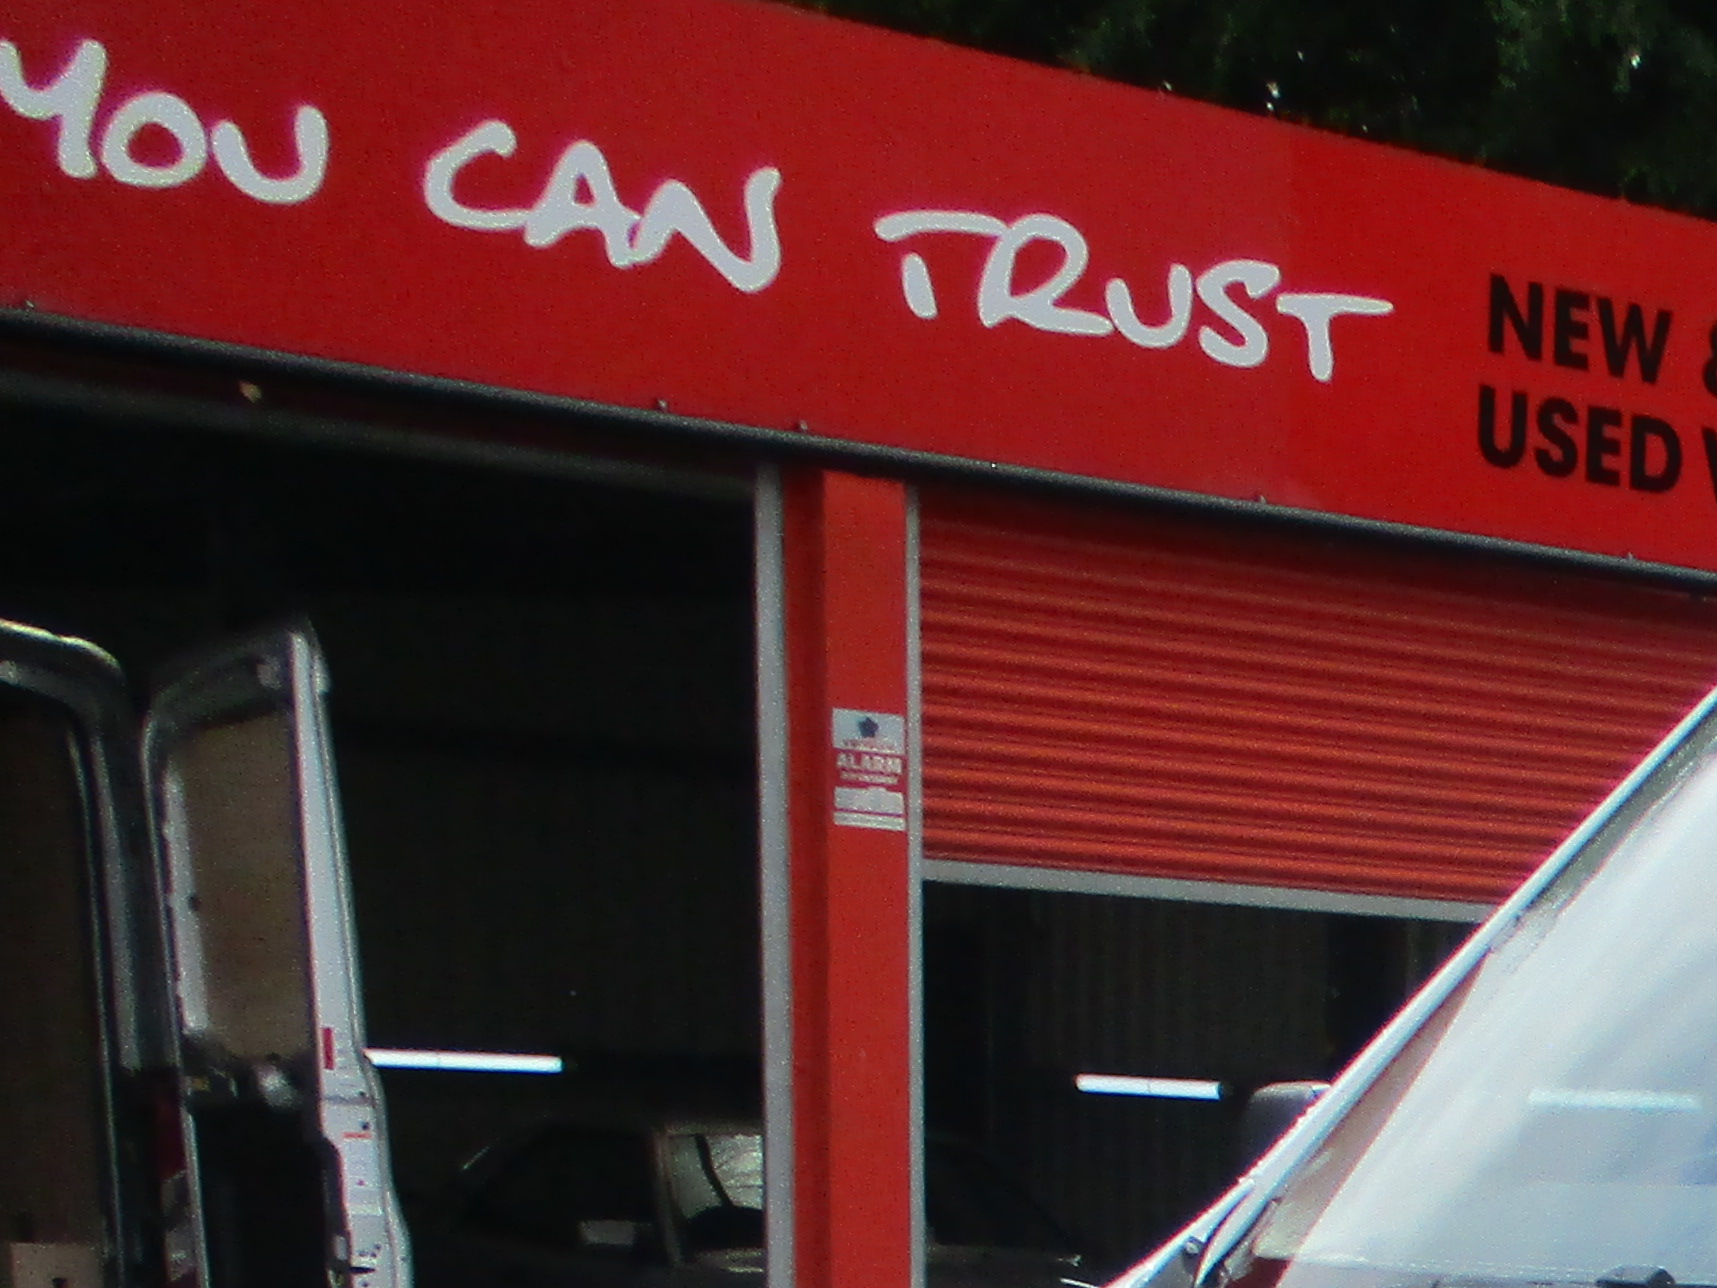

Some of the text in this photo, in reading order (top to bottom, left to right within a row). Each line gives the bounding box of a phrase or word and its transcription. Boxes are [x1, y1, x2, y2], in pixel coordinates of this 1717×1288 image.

[0, 39, 1394, 382] YOU CAN TRUST
[1488, 273, 1673, 384] NEW
[1477, 384, 1682, 493] USED
[837, 752, 902, 775] ALARM
